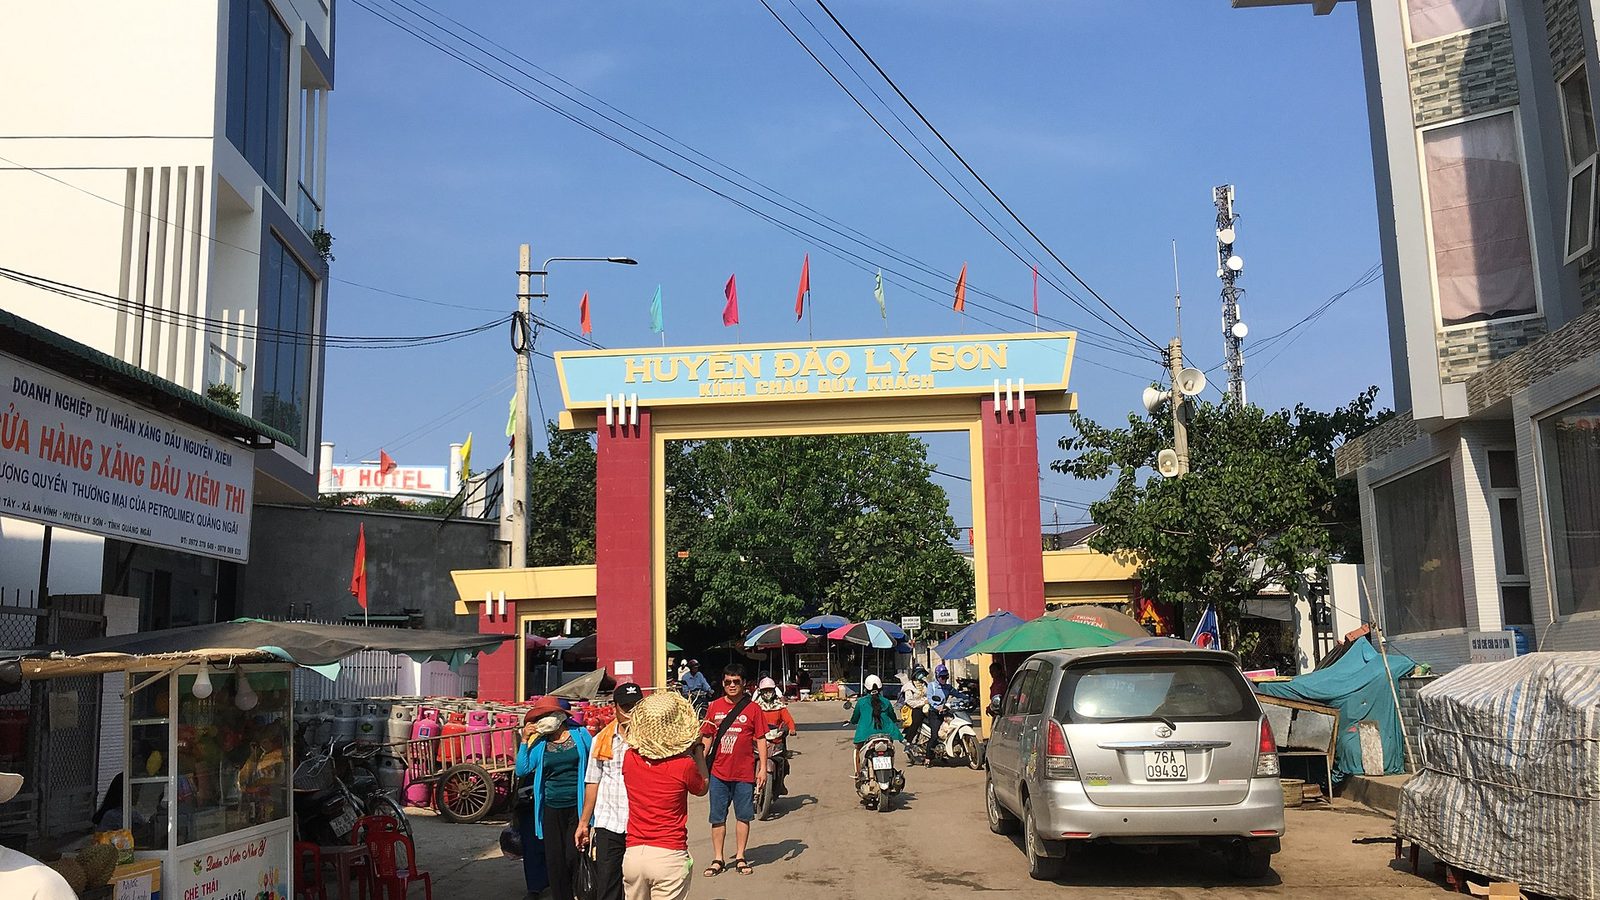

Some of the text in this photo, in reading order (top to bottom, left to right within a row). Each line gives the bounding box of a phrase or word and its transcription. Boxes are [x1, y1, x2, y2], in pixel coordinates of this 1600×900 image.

[775, 346, 850, 378] ĐẢO
[864, 344, 917, 375] LÝ
[930, 343, 1008, 372] SƠN
[700, 372, 935, 397] KÍNH CHÀO QUÝ KHÁCH
[13, 376, 51, 405] DOANH
[54, 391, 92, 420] NGHIỆP
[96, 407, 109, 424] TƯ
[110, 412, 136, 434] NHÂN
[138, 421, 161, 443] XĂNG
[214, 449, 232, 467] XIÊM
[0, 402, 245, 514] ỬA HÀNG XĂNG DẦU XIÊM THI
[359, 469, 431, 489] HOTEL
[72, 482, 110, 503] THƯƠNG
[111, 492, 128, 509] MẠI
[129, 494, 146, 513] CỦA
[148, 501, 195, 523] PETROLIMEX
[196, 513, 221, 531] QUẢNG
[221, 521, 239, 534] NGÃI
[1154, 751, 1177, 765] 76A
[1147, 764, 1186, 778] 094.92
[202, 878, 219, 896] THÁI
